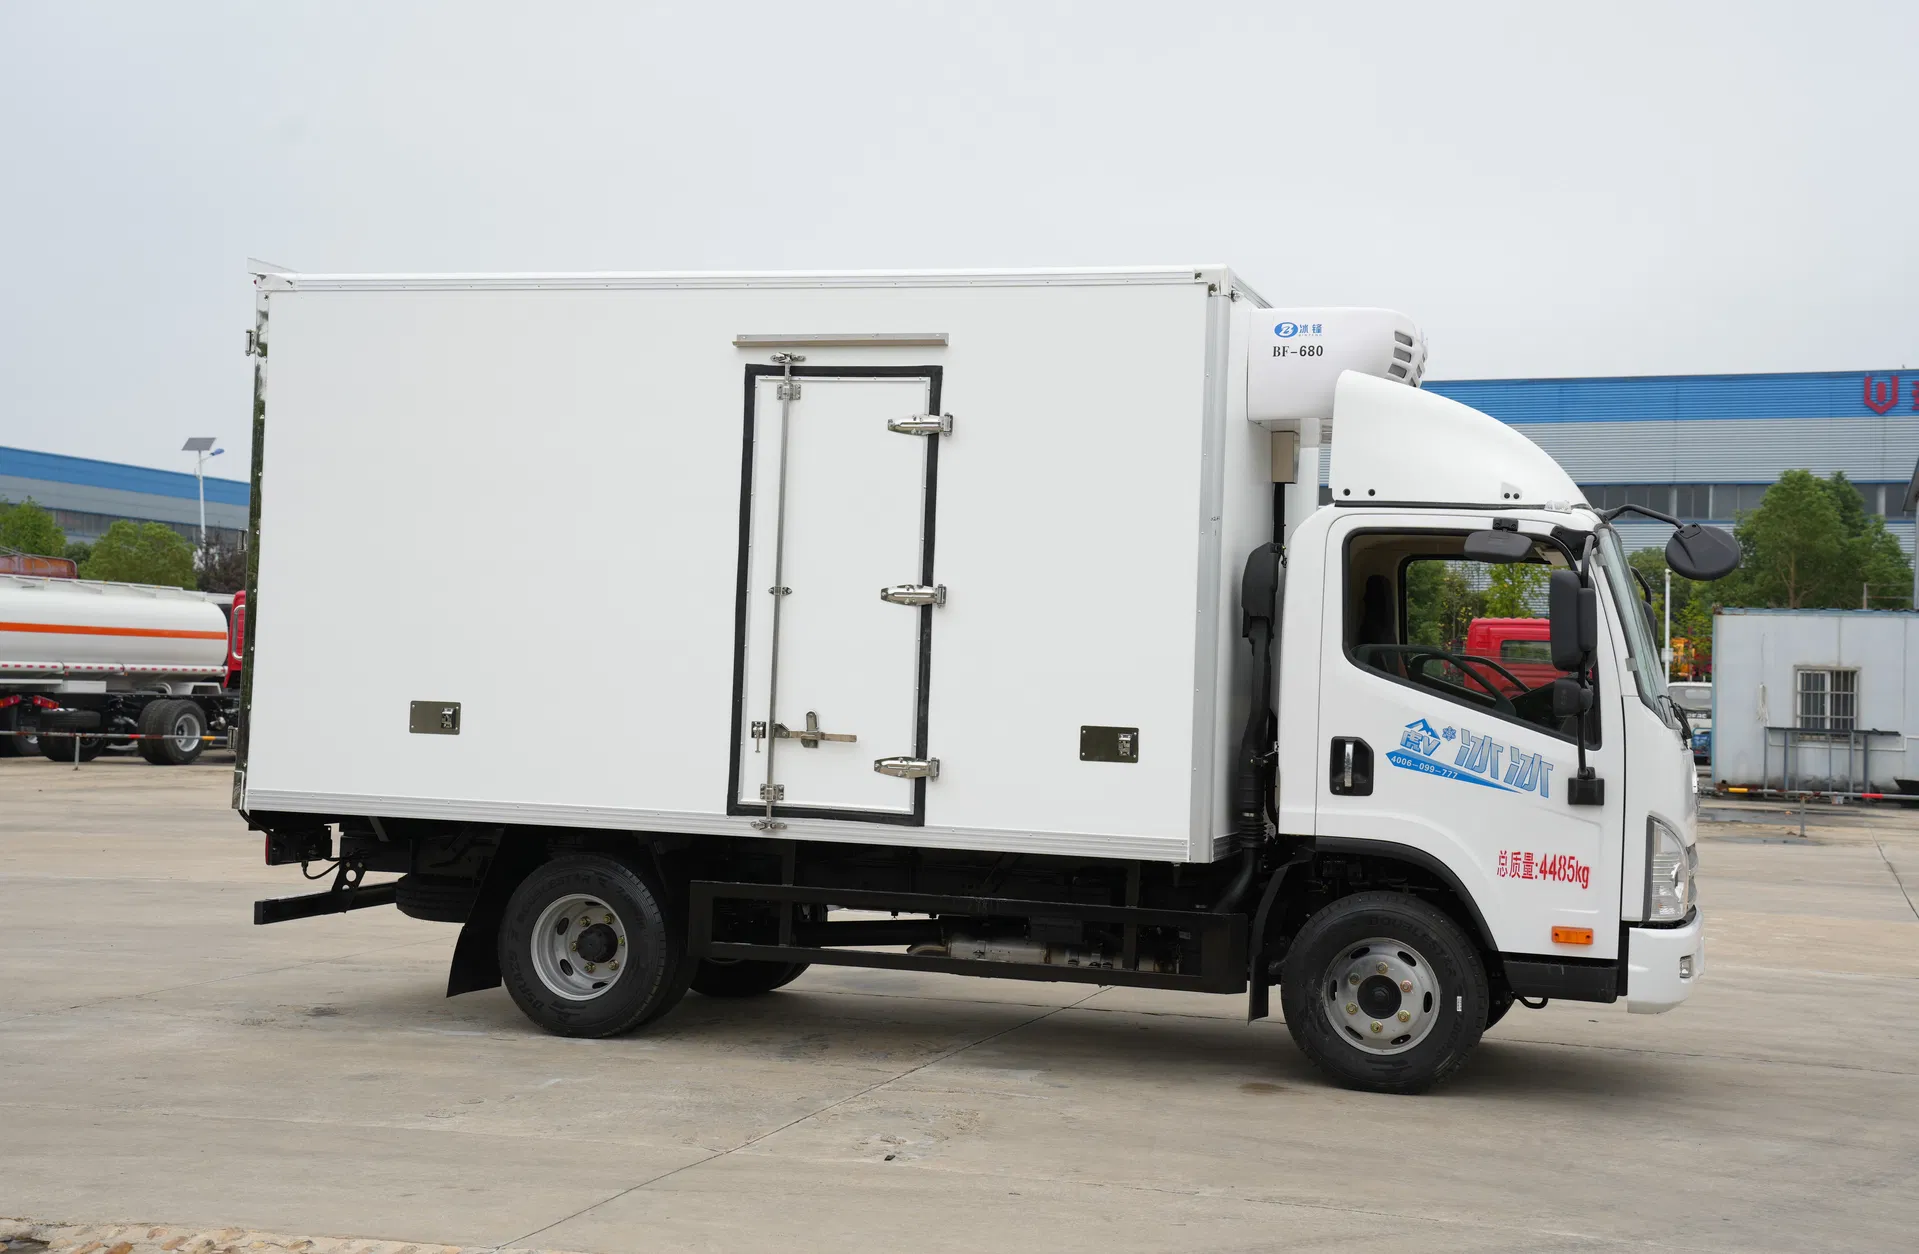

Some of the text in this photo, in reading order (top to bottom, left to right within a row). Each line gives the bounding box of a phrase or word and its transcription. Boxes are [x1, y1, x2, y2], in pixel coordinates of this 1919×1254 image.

[1272, 345, 1324, 357] BF-680
[1391, 755, 1458, 779] 4006-099-777
[1497, 850, 1590, 889] 总质量:4485kg
